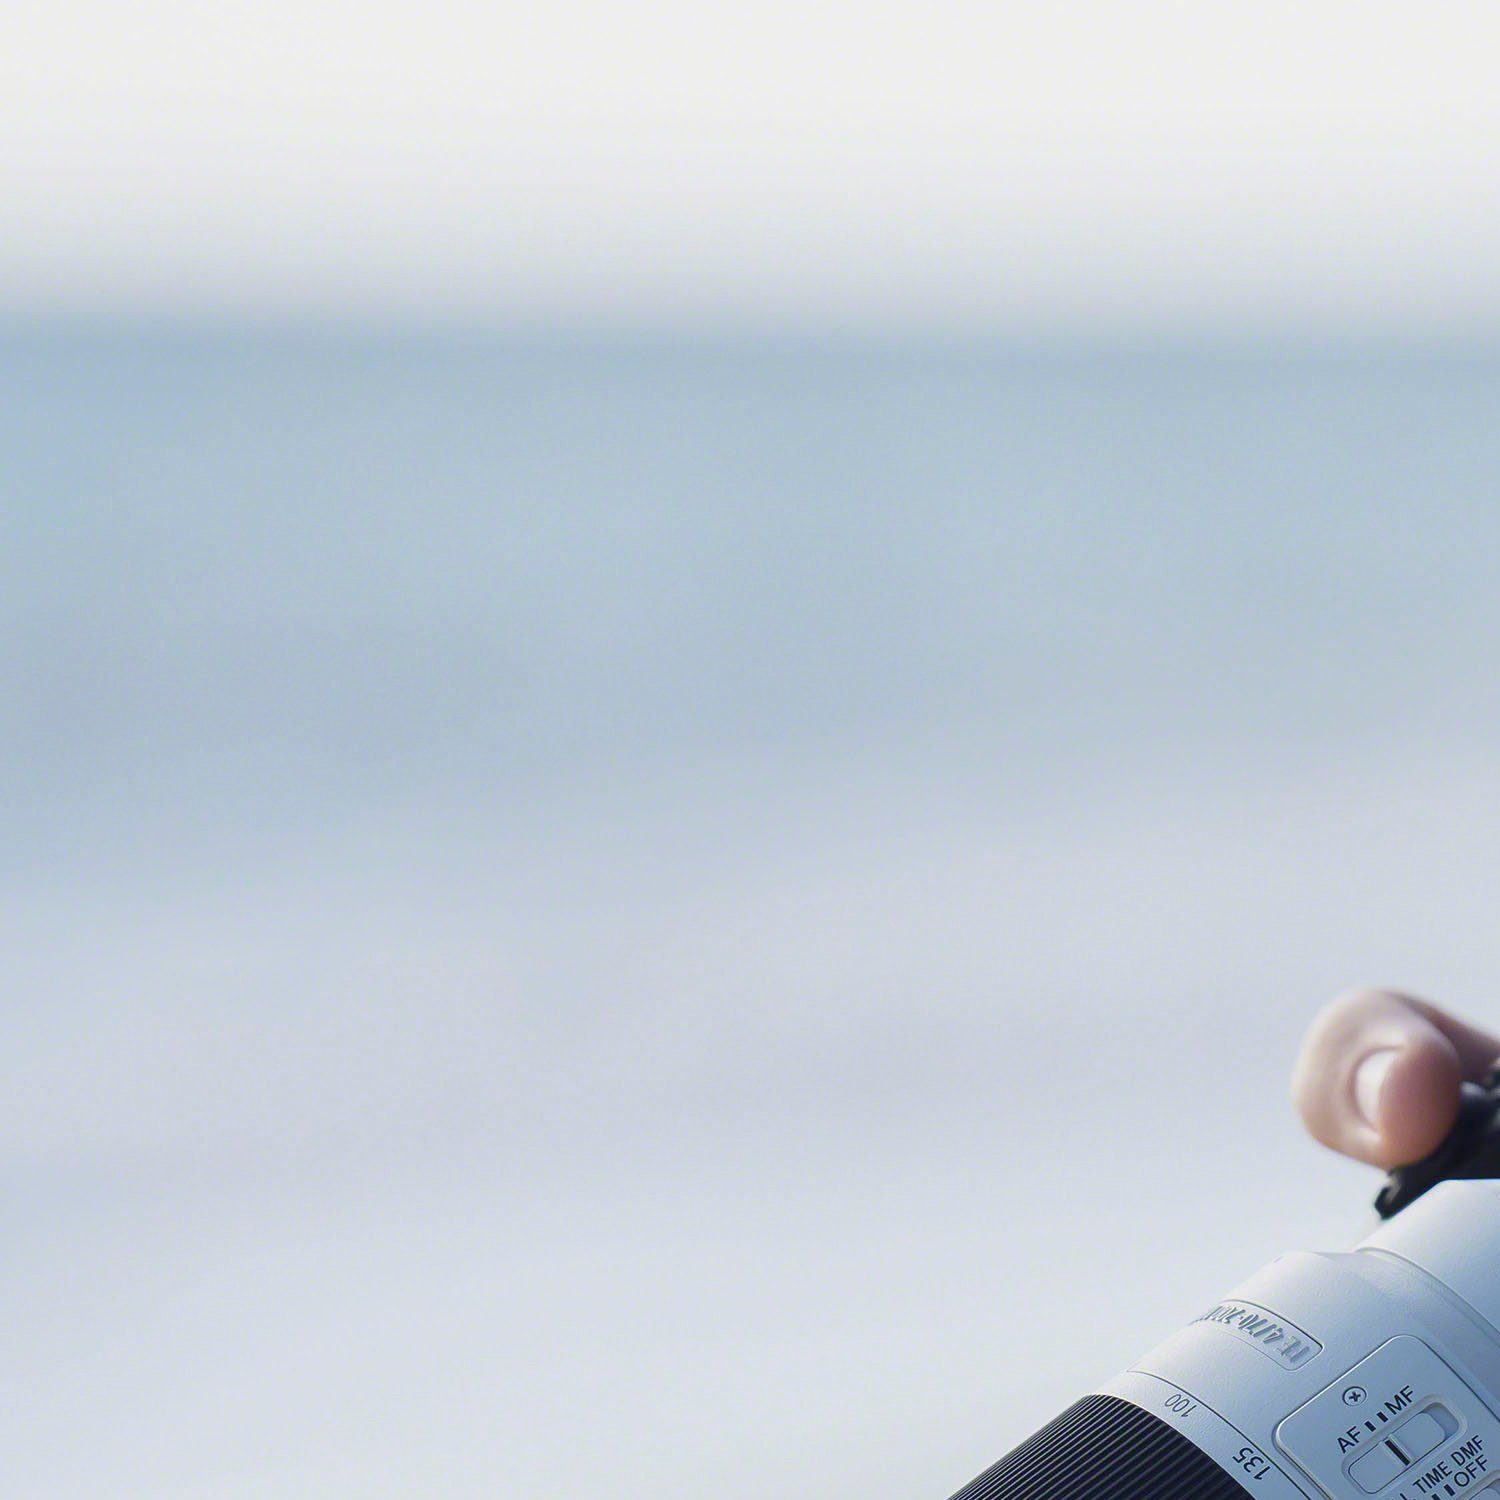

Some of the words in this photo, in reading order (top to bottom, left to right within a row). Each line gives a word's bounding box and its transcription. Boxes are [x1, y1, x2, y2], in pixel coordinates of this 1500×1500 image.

[1165, 1393, 1198, 1418] 100
[1337, 1425, 1362, 1453] AF
[1385, 1385, 1415, 1415] MF
[1231, 1446, 1271, 1480] 135
[1412, 1460, 1453, 1493] TIME
[1450, 1434, 1485, 1467] DMF
[1455, 1456, 1489, 1488] OFF
